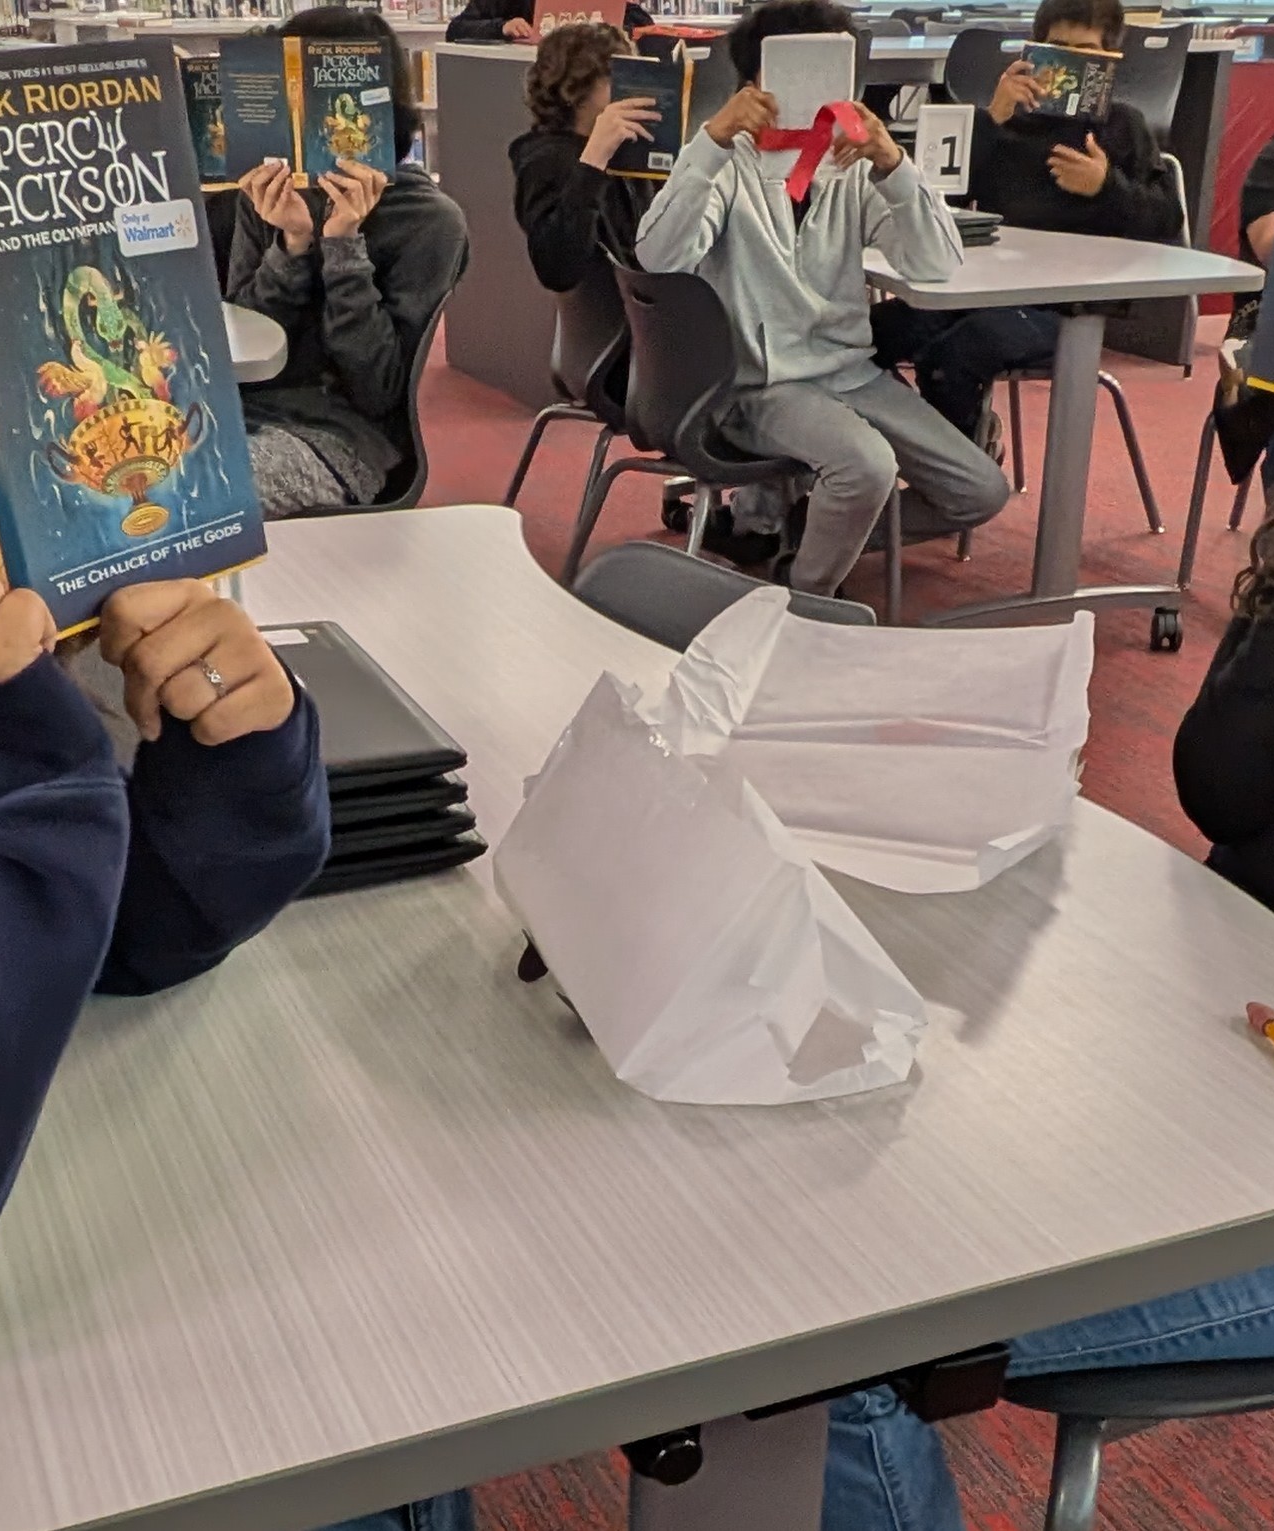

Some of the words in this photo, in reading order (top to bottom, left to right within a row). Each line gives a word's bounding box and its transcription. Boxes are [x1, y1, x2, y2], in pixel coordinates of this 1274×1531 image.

[308, 45, 333, 55] RICK
[322, 54, 367, 68] PERCY
[13, 67, 40, 79] TIMES
[313, 65, 380, 88] JACKSON
[23, 75, 163, 114] RIORDAN
[940, 135, 961, 176] 1
[121, 213, 141, 225] Only
[22, 232, 52, 249] THE
[52, 220, 118, 244] OLYMPIAN
[124, 222, 175, 243] Walmart
[56, 575, 86, 595] THE
[88, 553, 149, 584] CHALICE
[150, 546, 170, 562] OF
[173, 536, 203, 555] THE
[204, 522, 243, 544] GODS
